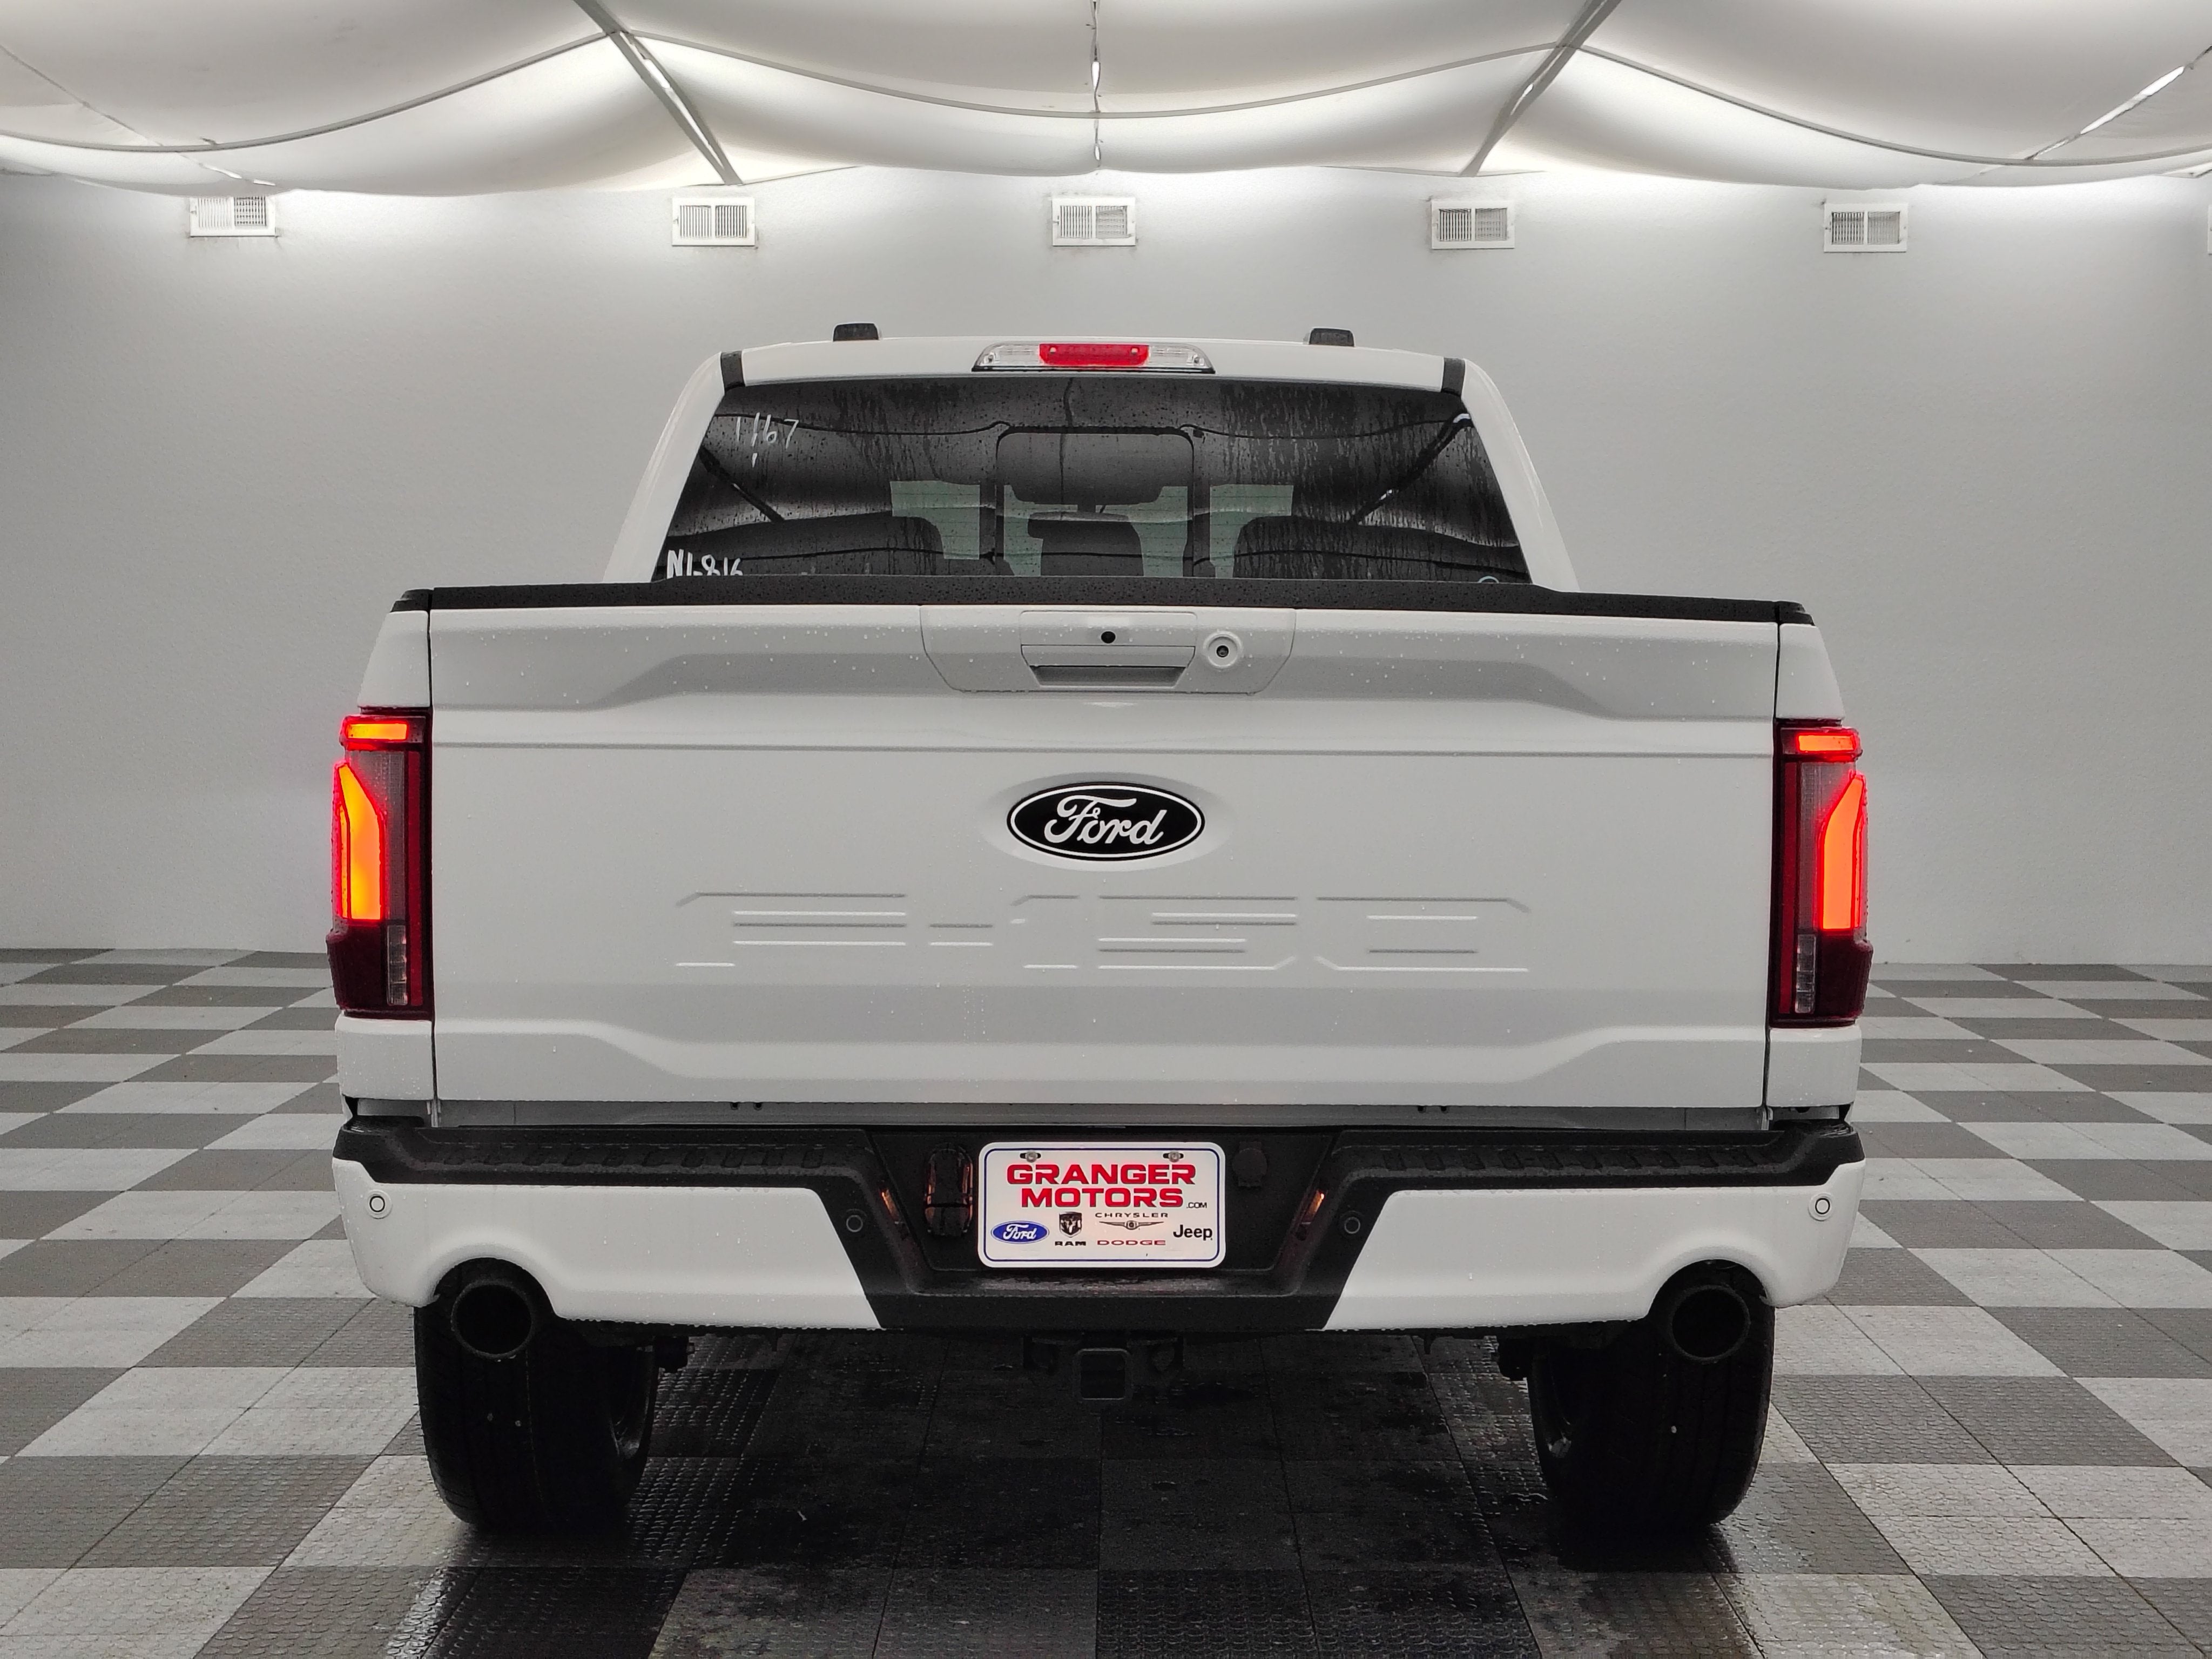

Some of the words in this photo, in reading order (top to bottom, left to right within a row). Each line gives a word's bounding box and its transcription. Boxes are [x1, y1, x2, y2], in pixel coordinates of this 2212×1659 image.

[1044, 795, 1168, 845] Ford
[1007, 1164, 1196, 1185] GRANGER
[1021, 1188, 1184, 1208] MOTORS
[1002, 1223, 1037, 1240] Ford
[1173, 1224, 1213, 1241] Jeep
